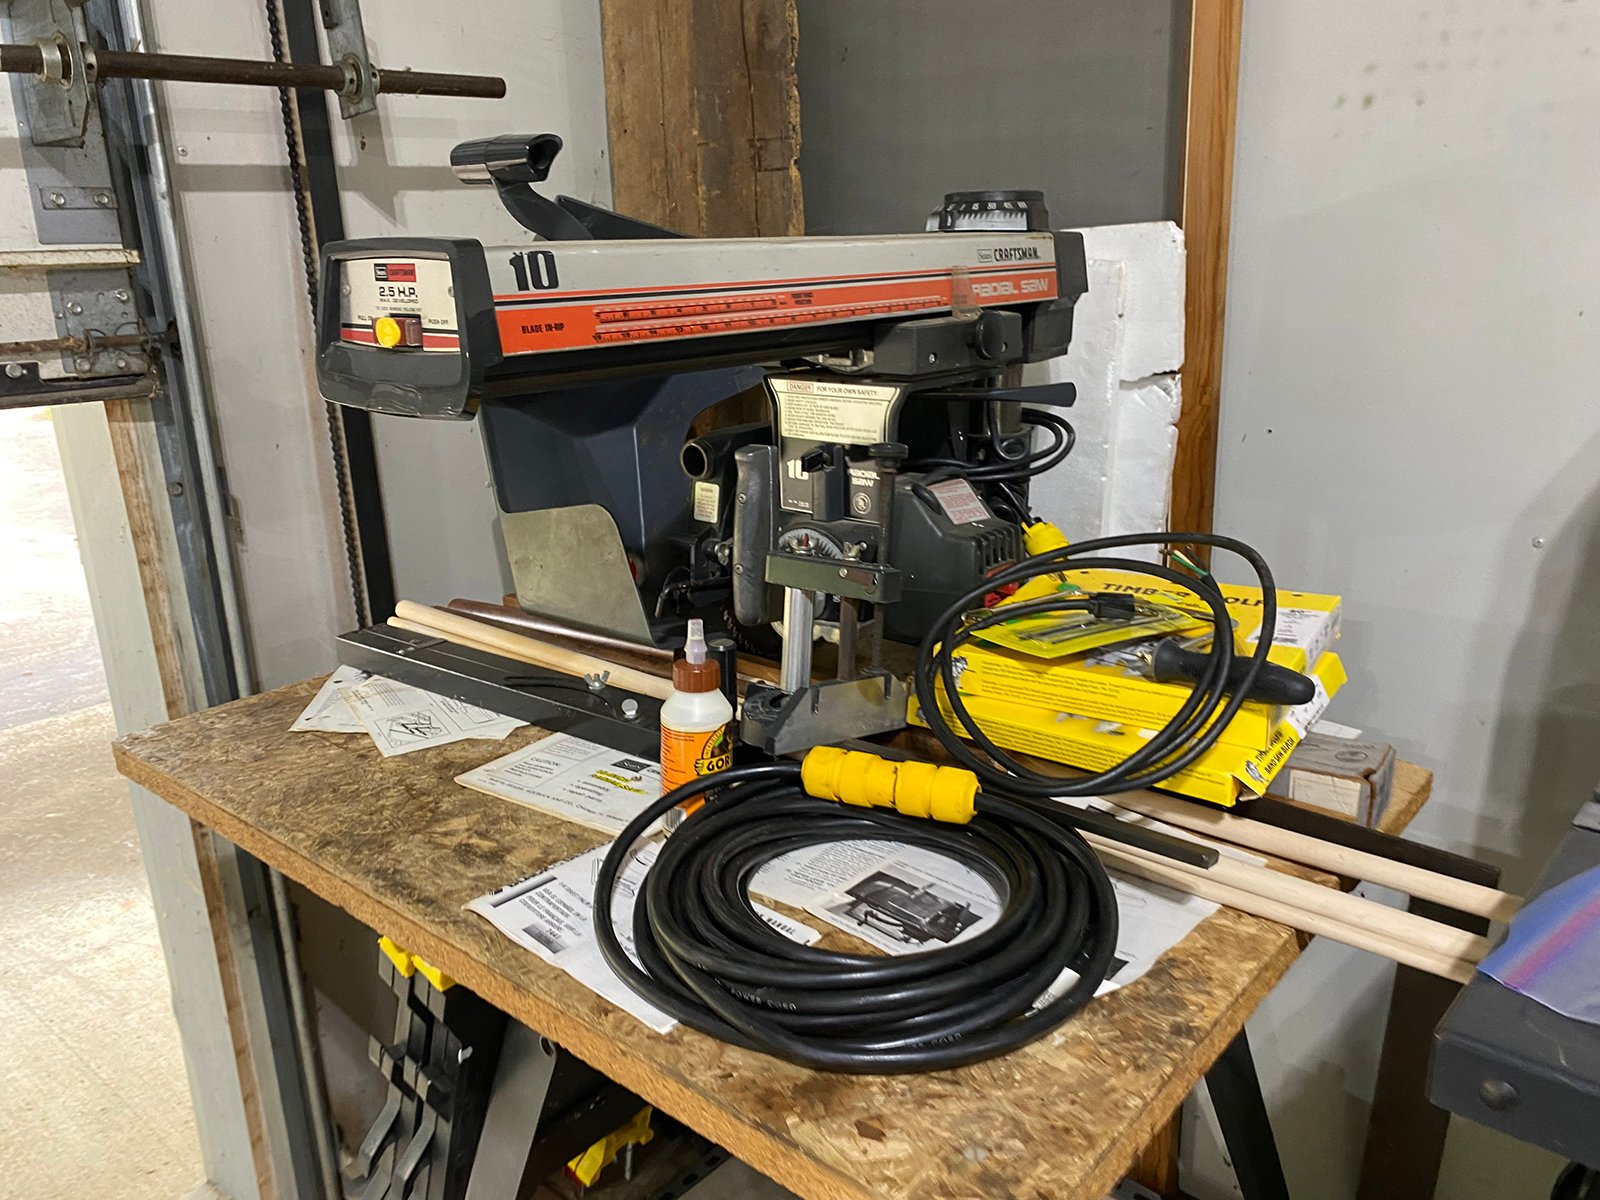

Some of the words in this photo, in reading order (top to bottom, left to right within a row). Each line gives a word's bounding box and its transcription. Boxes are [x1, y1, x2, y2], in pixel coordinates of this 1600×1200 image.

[508, 250, 559, 291] 10
[378, 286, 395, 297] 2.5
[397, 286, 418, 298] H.P.
[971, 281, 1019, 297] RADIAL
[1020, 278, 1050, 293] SAW
[521, 324, 543, 334] BLADE
[789, 382, 811, 391] DANGER
[766, 917, 796, 935] MANUAL
